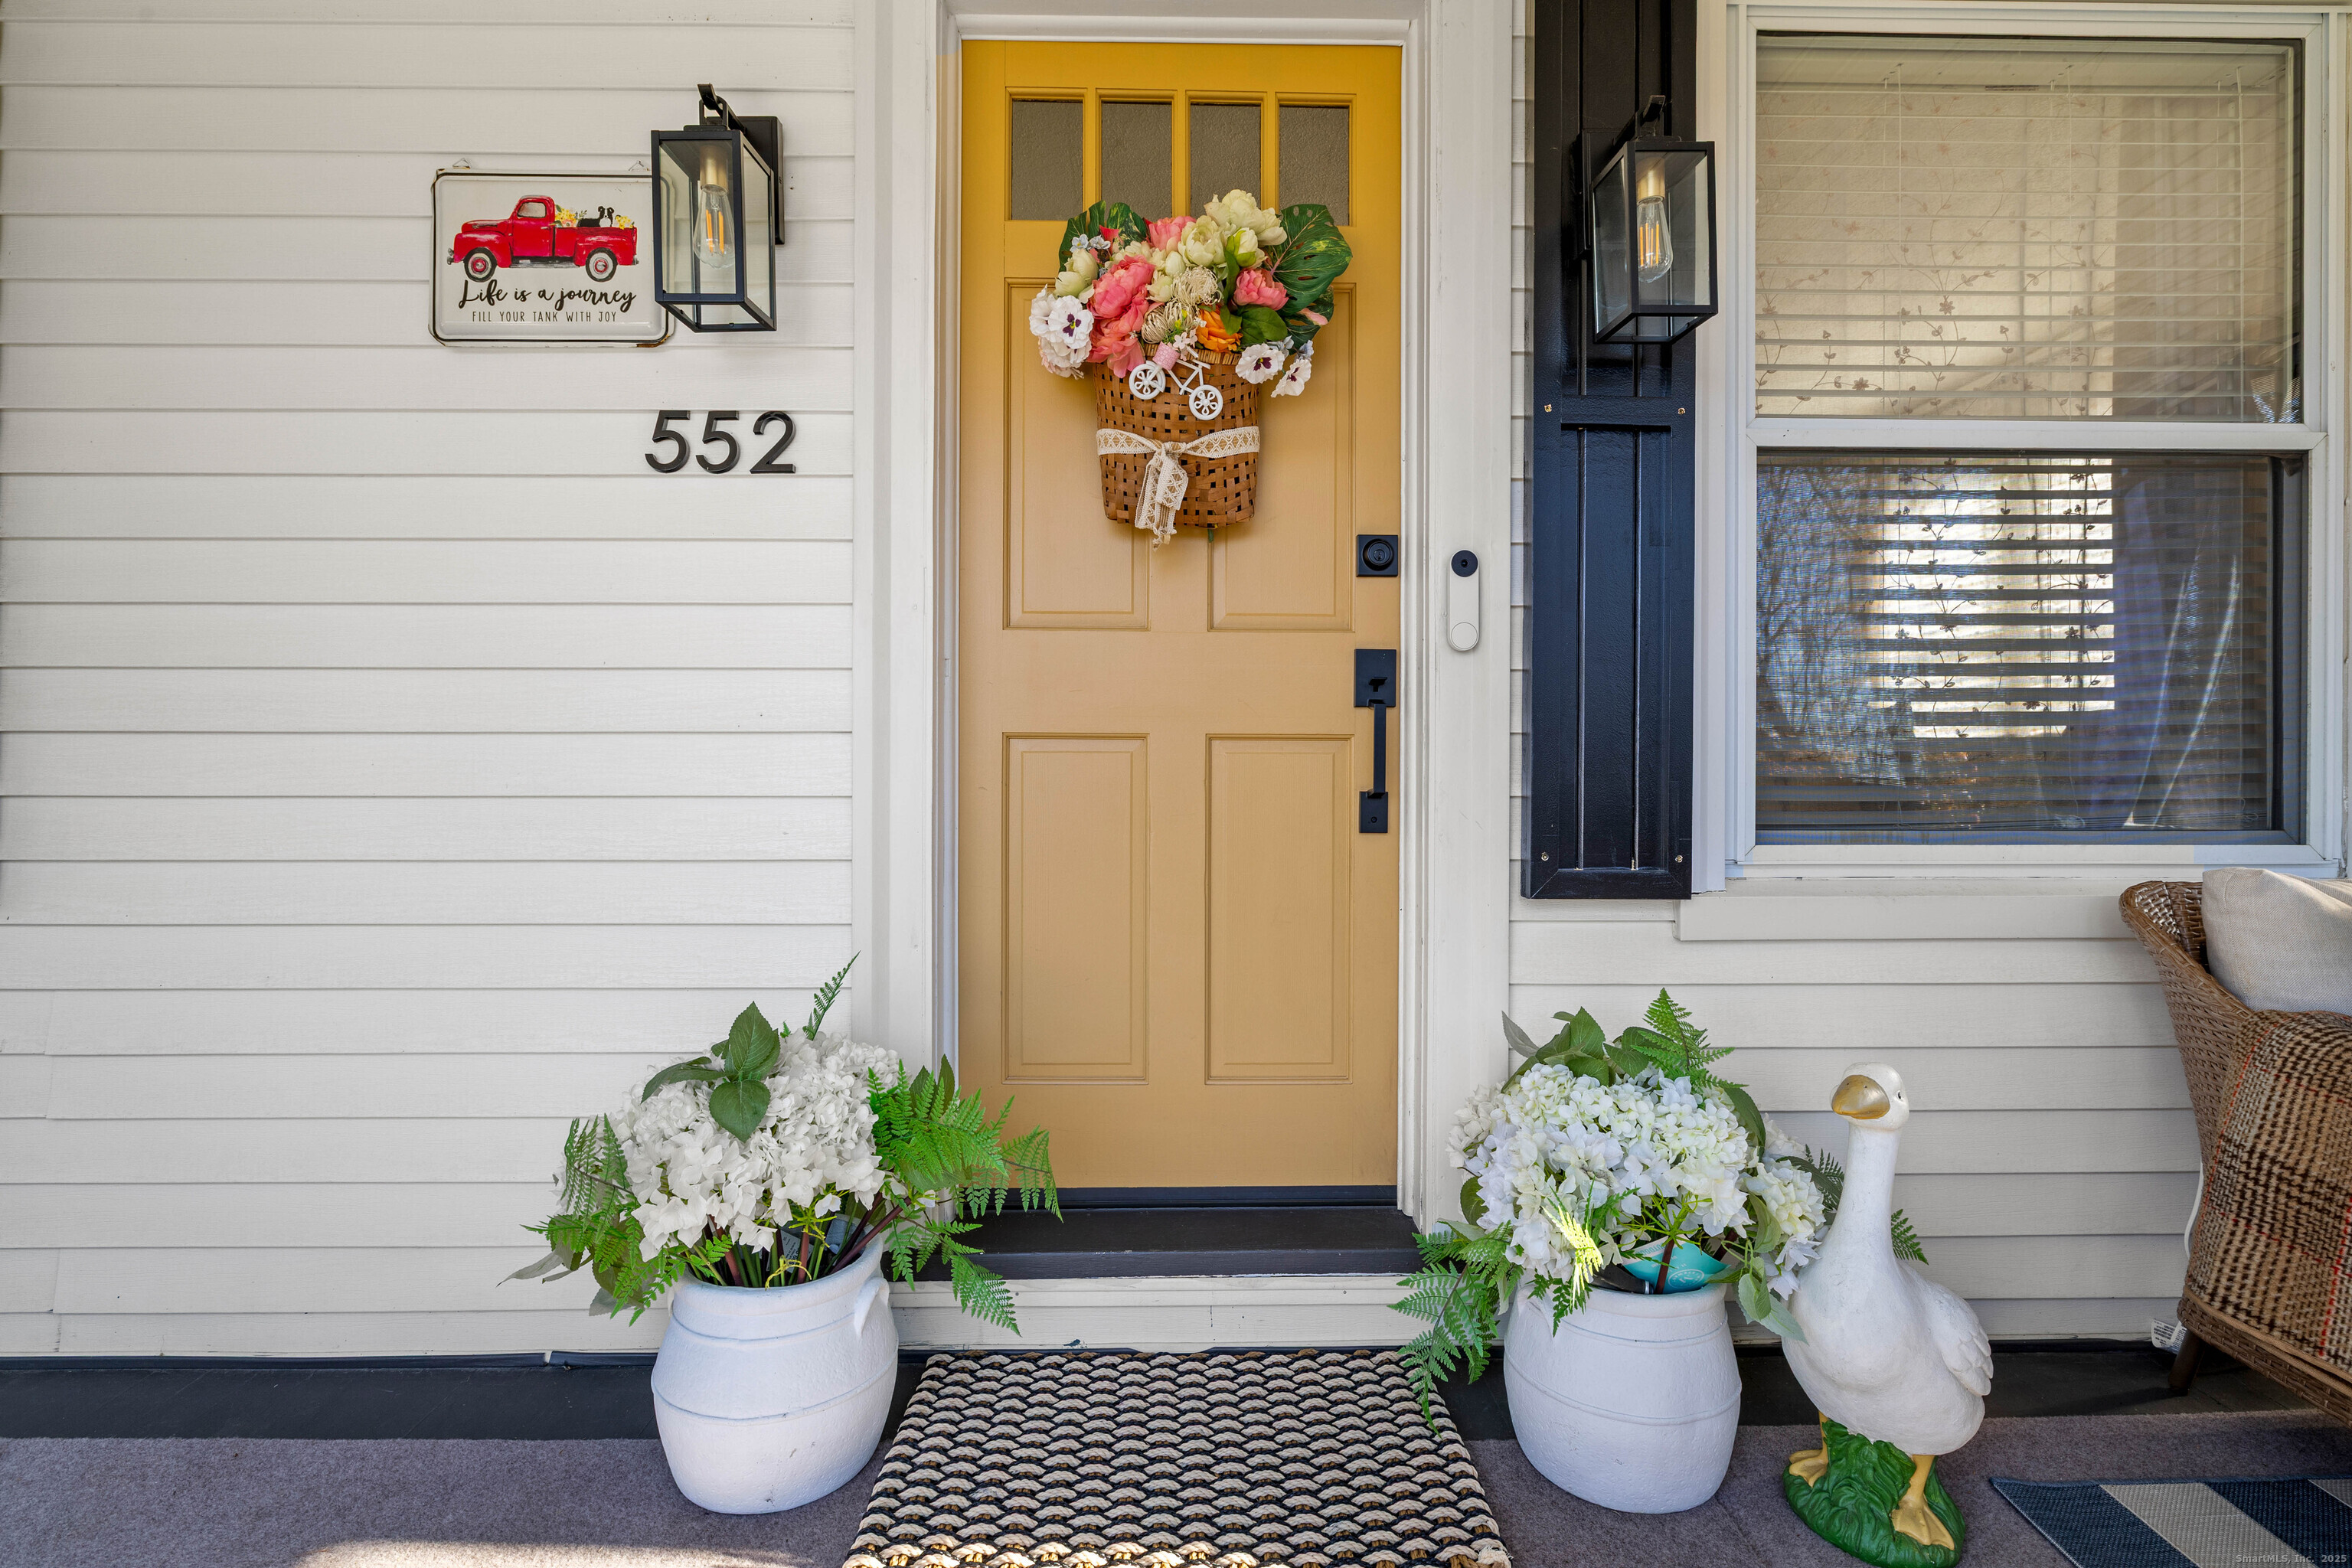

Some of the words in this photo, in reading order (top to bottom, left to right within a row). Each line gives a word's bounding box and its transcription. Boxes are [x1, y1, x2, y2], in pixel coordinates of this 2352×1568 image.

[459, 279, 508, 309] Life
[514, 286, 532, 302] is
[538, 289, 554, 301] a
[554, 287, 636, 313] journey
[472, 312, 492, 322] FILL
[499, 312, 525, 322] YOUR
[532, 312, 558, 322] TANK
[566, 312, 592, 322] WITH
[598, 312, 617, 322] JOY
[645, 410, 796, 474] 552
